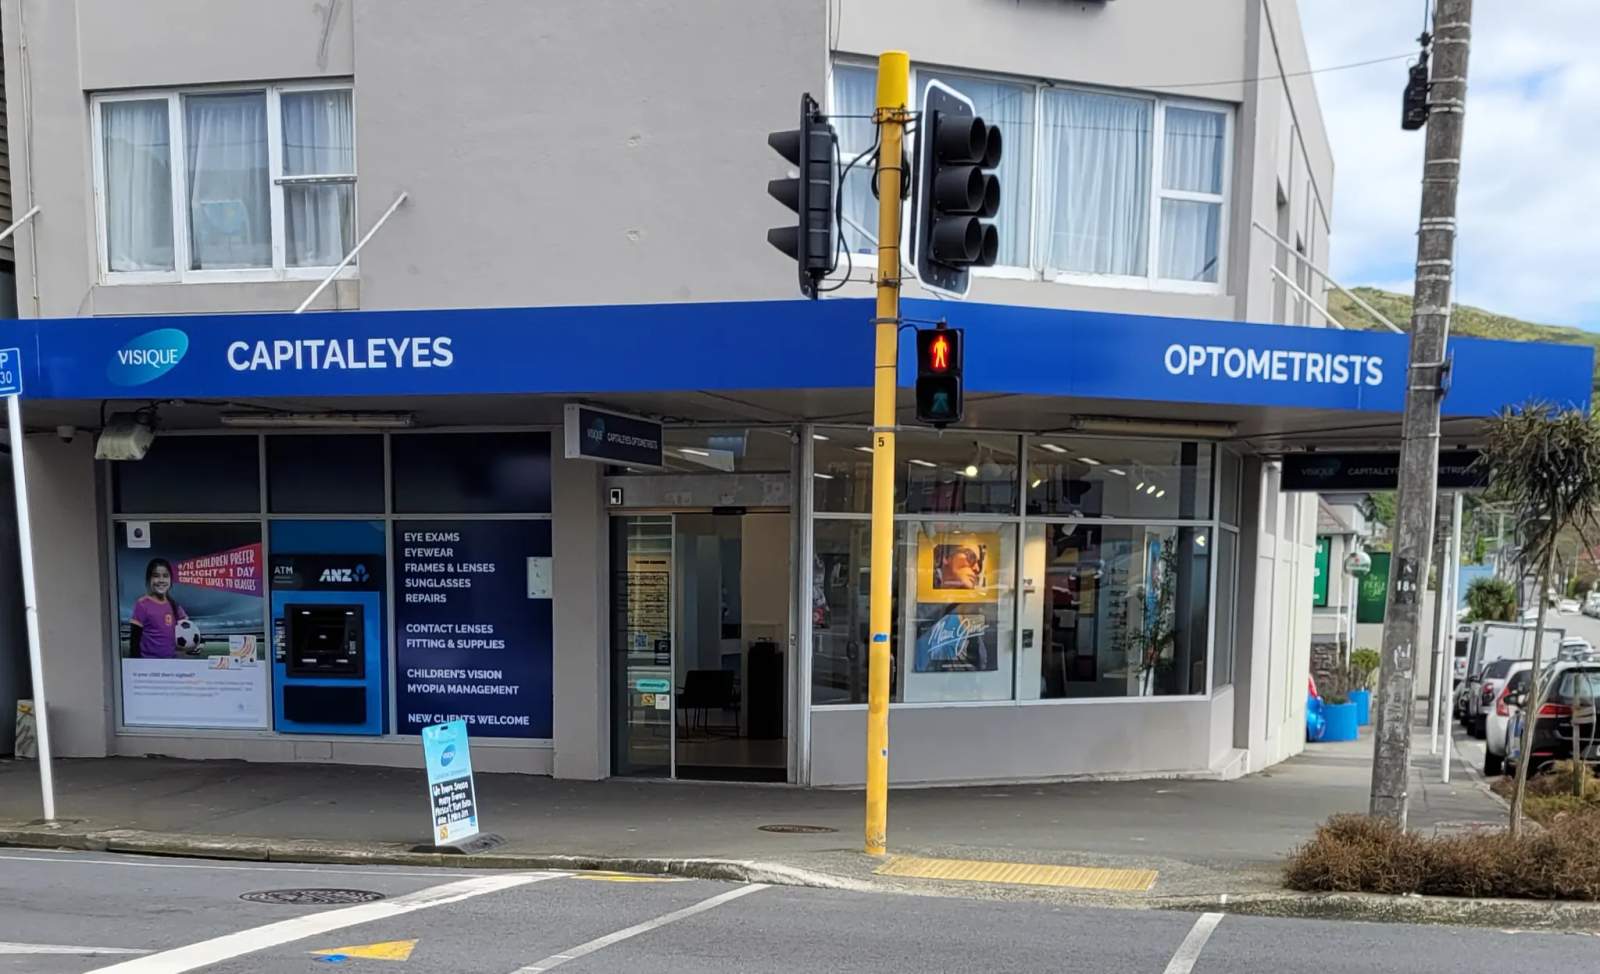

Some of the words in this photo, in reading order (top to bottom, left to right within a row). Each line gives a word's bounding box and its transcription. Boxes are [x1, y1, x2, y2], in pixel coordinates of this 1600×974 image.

[227, 336, 454, 371] CAPITALEYES
[117, 349, 179, 369] VISIQUE
[1164, 343, 1383, 386] OPTOMETRISTS
[878, 436, 885, 447] 5
[404, 532, 423, 542] EYE
[425, 533, 460, 542] EXAMS
[404, 548, 454, 557] EYEWEAR
[236, 567, 255, 577] DAY
[274, 566, 293, 575] ATM
[405, 563, 445, 572] FRAMES
[447, 563, 454, 573] &
[457, 563, 495, 573] LENSES
[319, 568, 353, 582] ANZ
[405, 578, 471, 588] SUNGLASSES
[405, 593, 447, 603] REPAIRS
[406, 624, 453, 633] CONTACT
[455, 624, 493, 633] LENSES
[406, 639, 446, 648] FITTING
[447, 639, 455, 648] &
[457, 640, 505, 649] SUPPLIES
[407, 669, 466, 679] CHILDREN'S
[467, 670, 502, 679] VISION
[407, 684, 446, 694] MYOPIA
[447, 685, 519, 695] MANAGEMENT
[408, 713, 432, 723] NEW
[433, 714, 476, 724] CLIENTS
[477, 715, 530, 725] WELCOME
